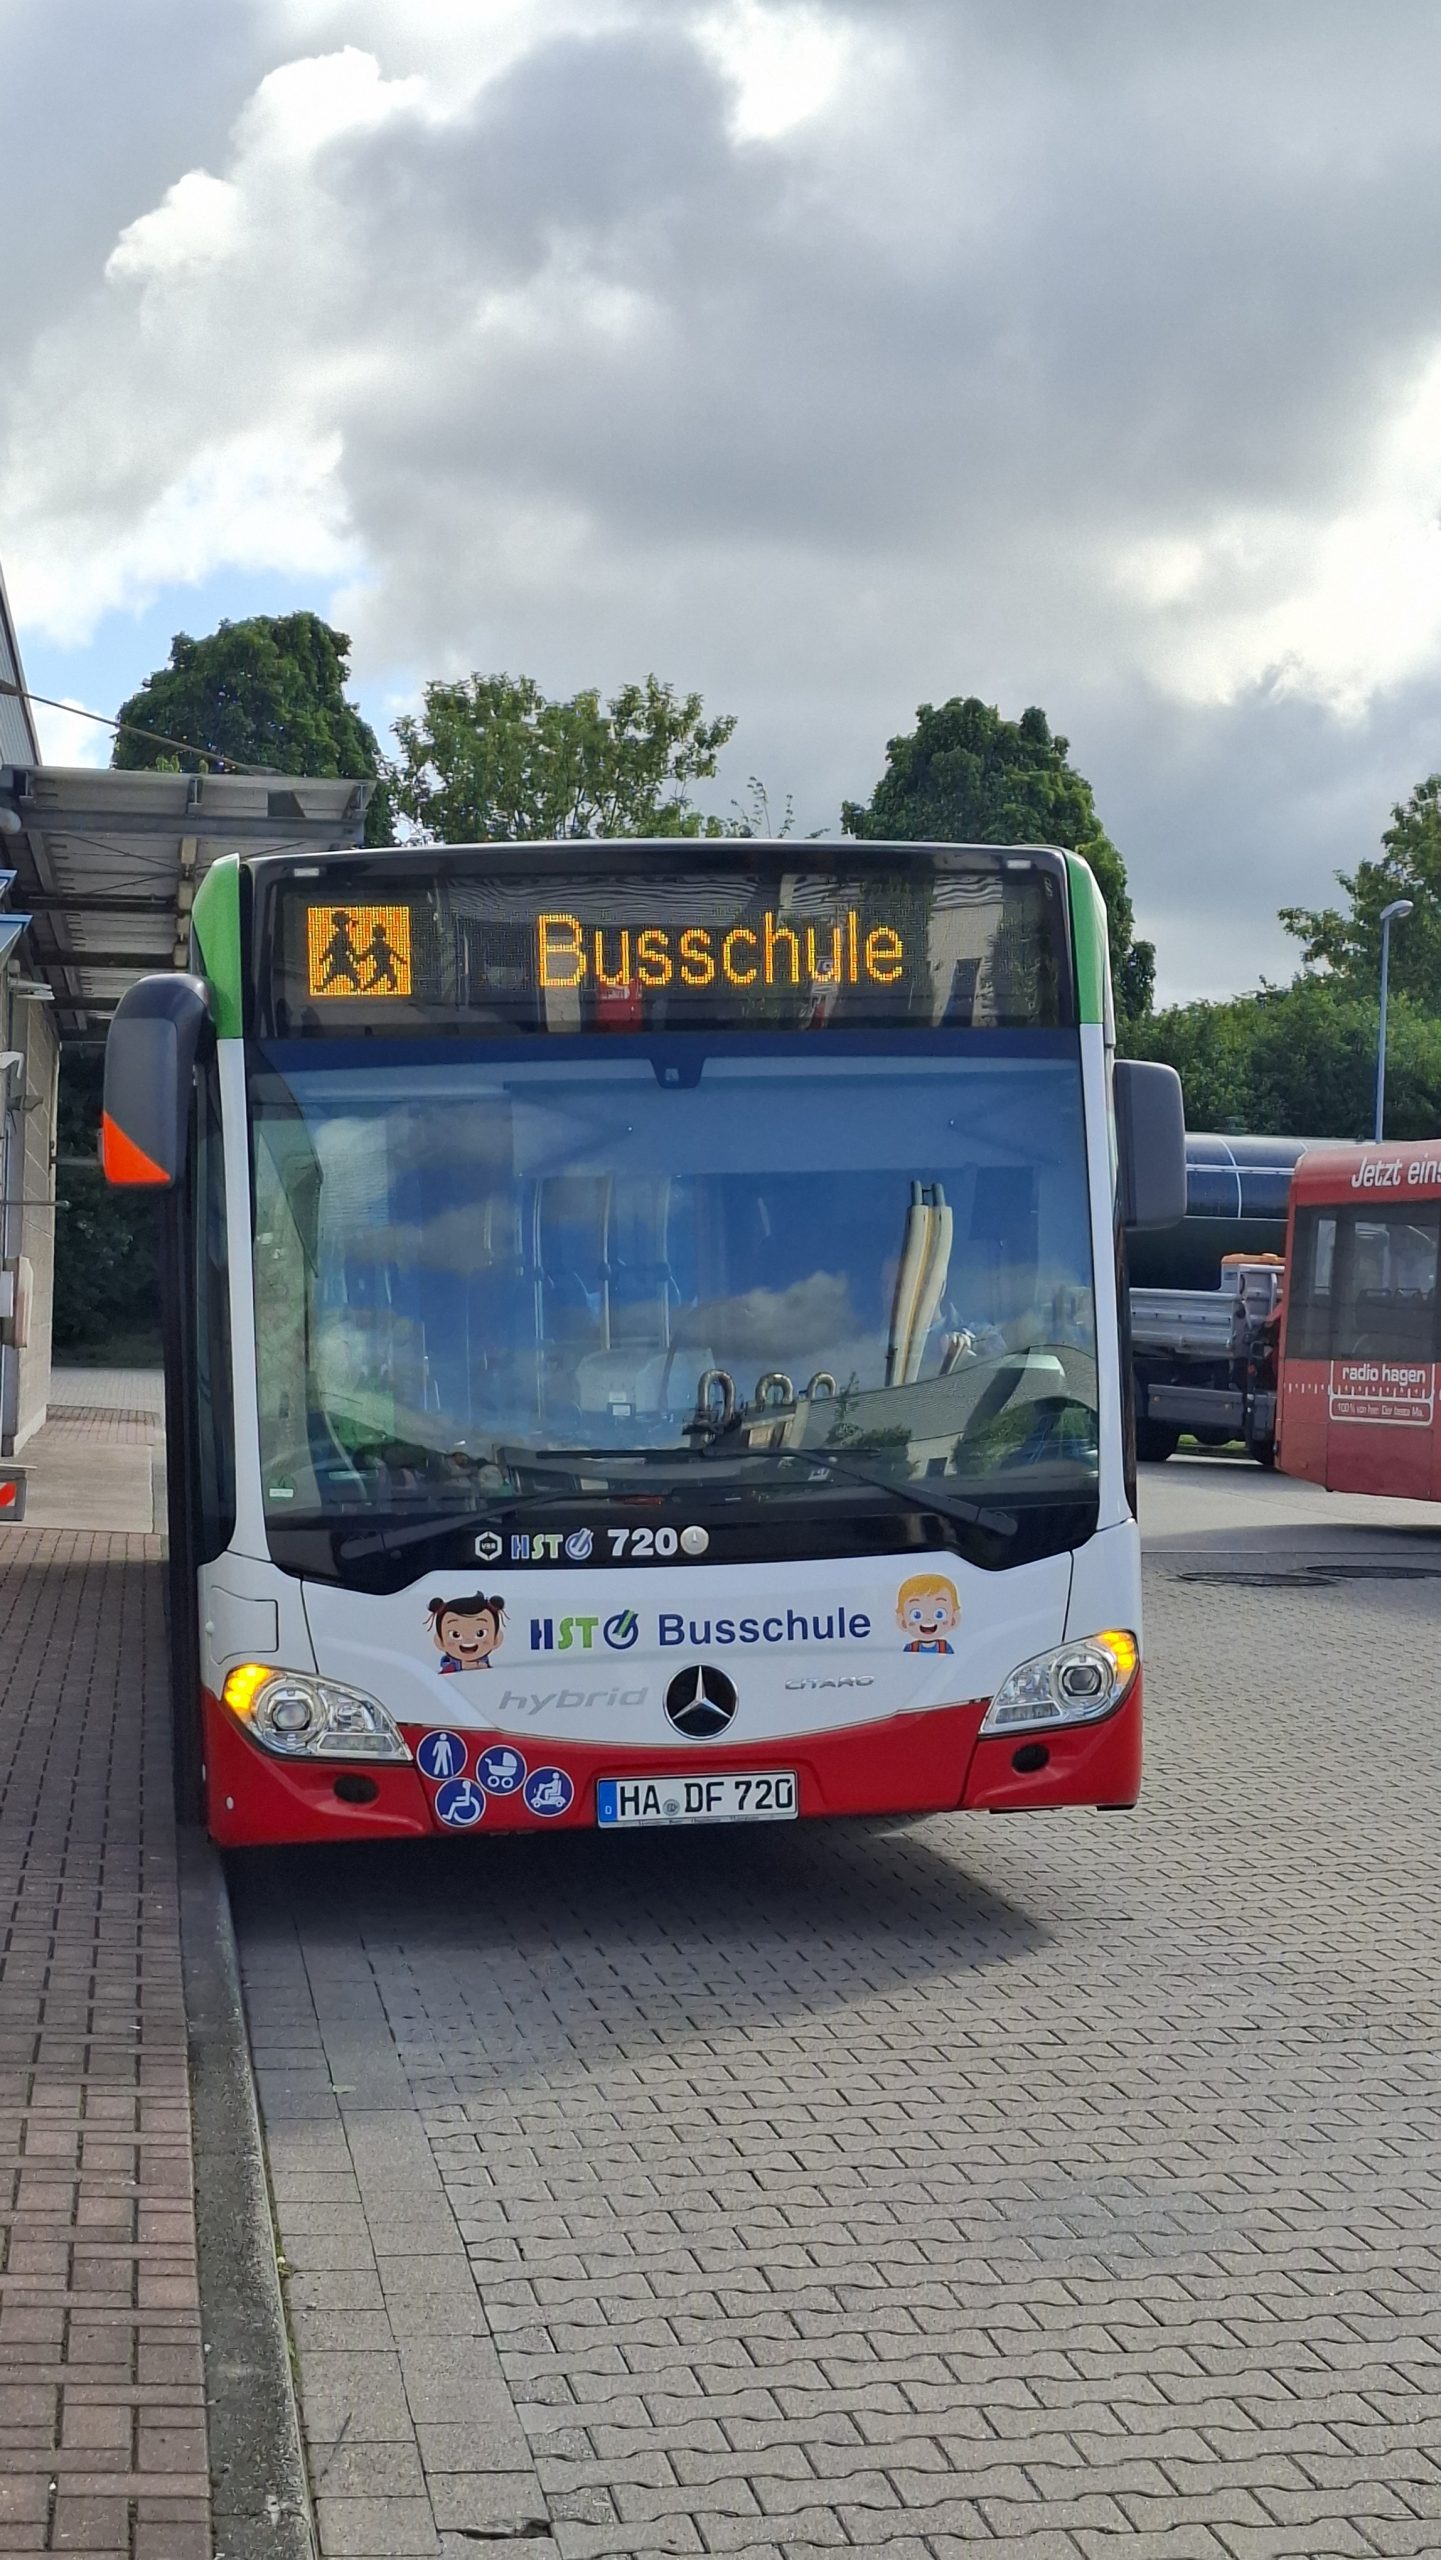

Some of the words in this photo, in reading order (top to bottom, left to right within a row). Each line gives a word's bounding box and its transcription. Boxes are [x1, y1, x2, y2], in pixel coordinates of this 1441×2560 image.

[538, 911, 904, 986] Busschule
[1351, 1156, 1402, 1188] Jetzt
[1342, 1363, 1378, 1381] radio
[1382, 1363, 1425, 1386] hagen
[511, 1534, 563, 1559] HST
[607, 1527, 678, 1556] 720
[530, 1617, 598, 1650] HST
[659, 1607, 871, 1646] Busschule
[785, 1675, 874, 1690] CITARO
[499, 1686, 648, 1715] hybrid
[605, 1804, 612, 1815] D
[620, 1785, 661, 1816] HA
[684, 1781, 724, 1813] DF
[734, 1778, 793, 1811] 720
